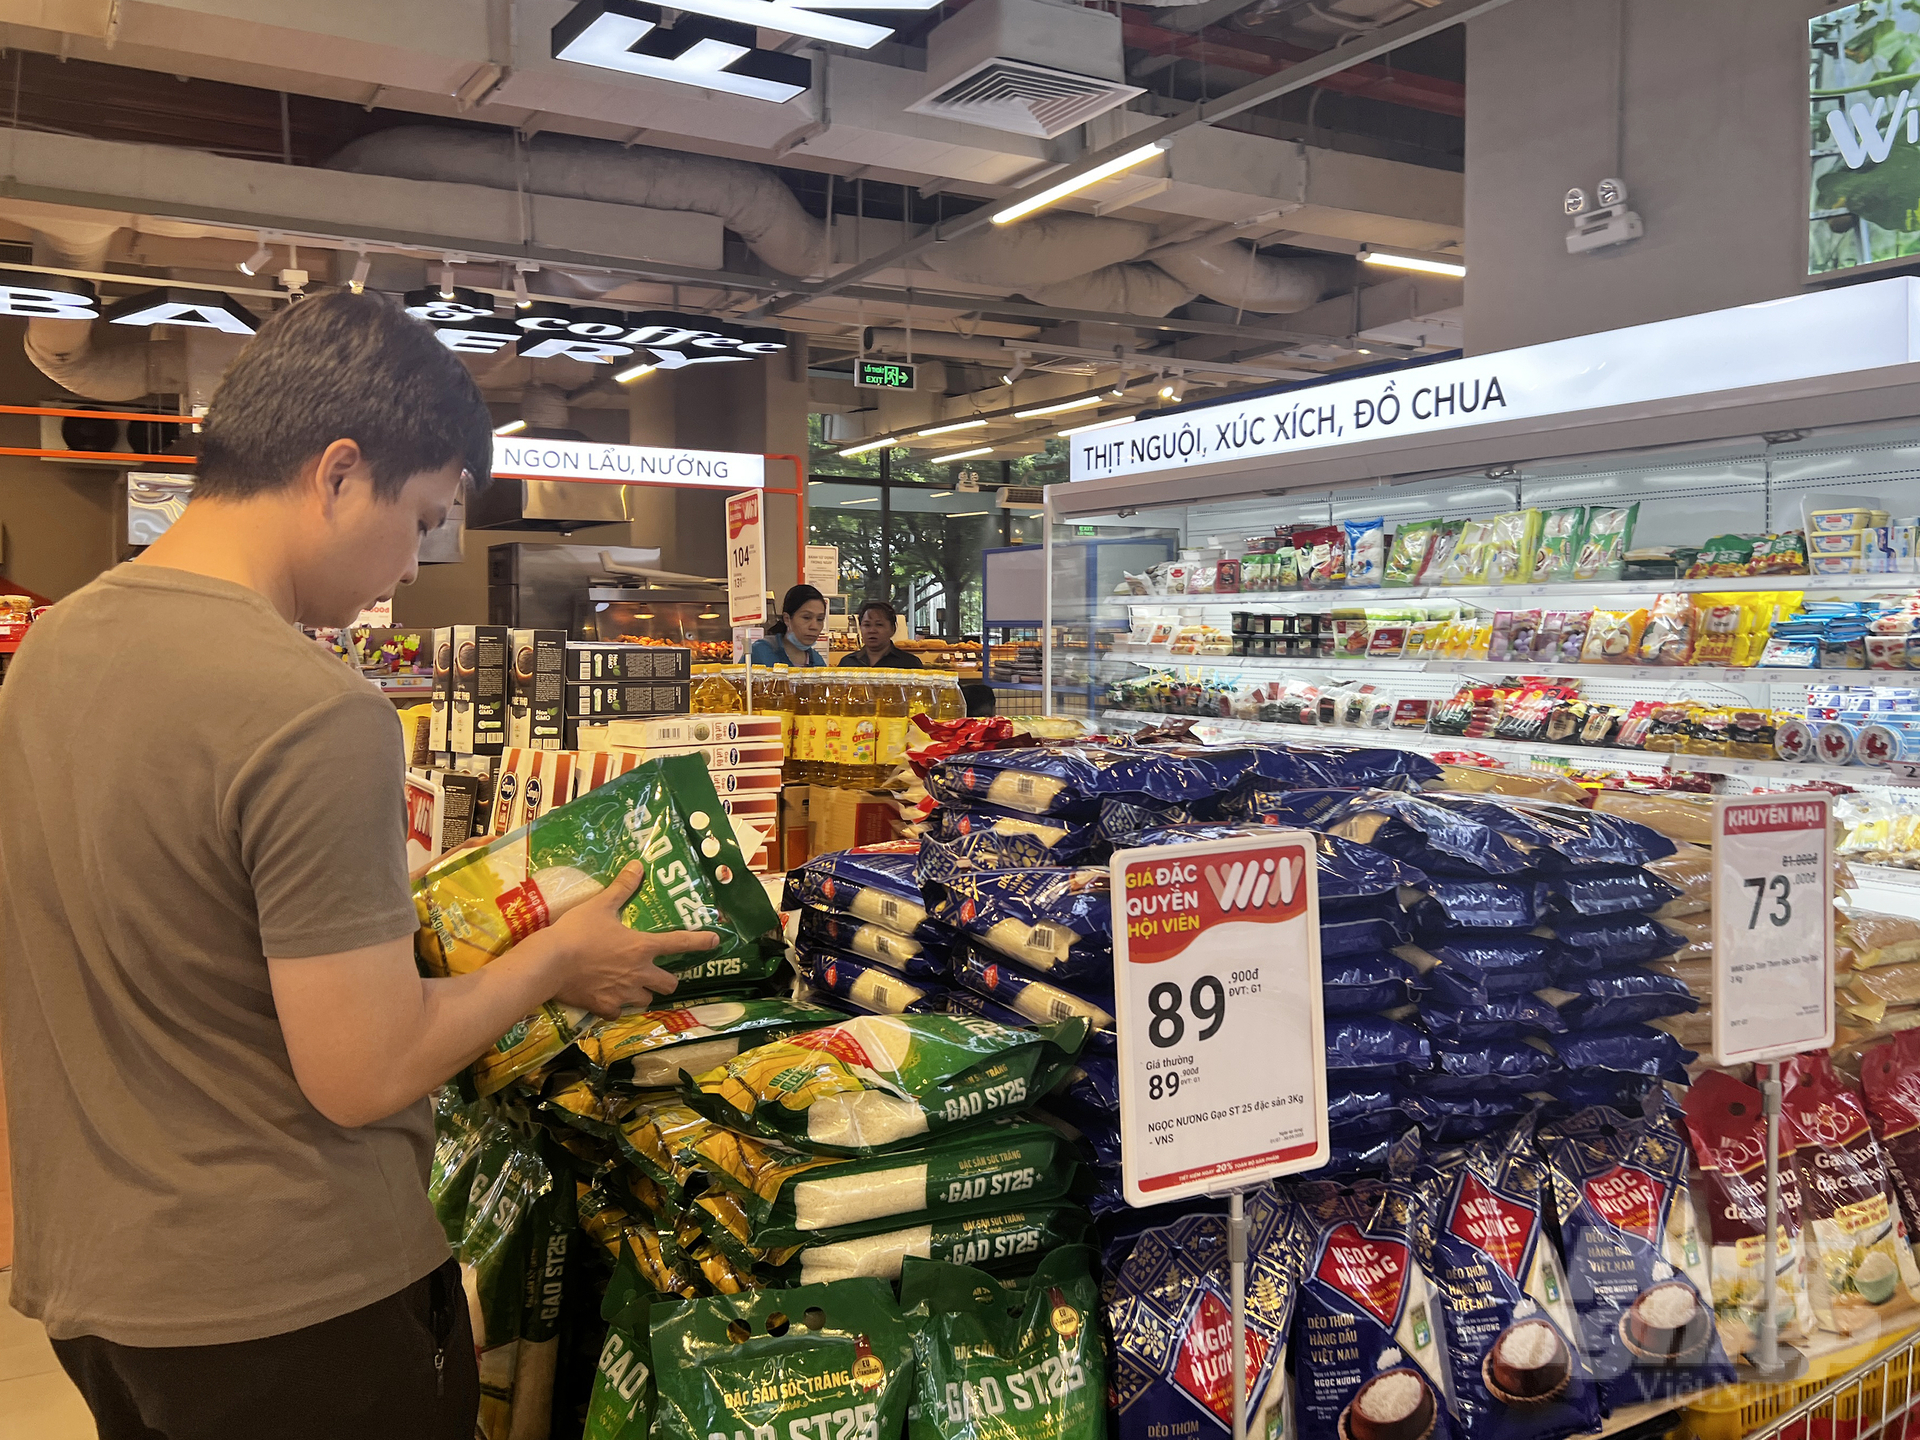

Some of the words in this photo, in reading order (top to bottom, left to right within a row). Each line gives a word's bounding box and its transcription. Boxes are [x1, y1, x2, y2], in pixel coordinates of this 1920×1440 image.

[405, 301, 495, 322] &
[514, 317, 788, 354] coffee
[866, 376, 884, 384] EXIT
[1083, 440, 1125, 474] THỊT
[1131, 421, 1207, 465] NGUỘI,
[1216, 412, 1266, 451] XÚC
[1274, 402, 1344, 443] XÍCH,
[1354, 379, 1400, 429] ĐỒ
[1411, 375, 1507, 420] CHUA
[504, 447, 579, 470] NGON
[588, 447, 635, 476] LẨU,
[640, 453, 729, 479] NƯỚNG
[733, 545, 750, 568] 104
[1728, 805, 1786, 827] KHUYẾN
[1791, 806, 1820, 828] MẠI
[624, 804, 673, 863] GẠO
[657, 859, 713, 931] ST25
[1125, 867, 1154, 888] GIÁ
[1155, 862, 1198, 888] ĐẶC
[1126, 887, 1199, 916] QUYỀN
[1743, 874, 1792, 930] 73
[1128, 919, 1158, 940] HỘI
[1162, 912, 1200, 934] VIÊN
[706, 957, 741, 978] ST25
[1228, 967, 1259, 984] .900đ
[1228, 986, 1249, 997] ĐVT:
[1251, 983, 1262, 994] G1
[1148, 974, 1226, 1048] 89
[1146, 1059, 1161, 1071] Giá
[1163, 1054, 1194, 1068] thường
[1148, 1071, 1180, 1101] 89
[944, 1091, 982, 1122] GẠO
[984, 1077, 1028, 1110] ST25
[1148, 1119, 1174, 1133] NGỌC
[1176, 1112, 1209, 1127] NƯƠNG
[1210, 1110, 1227, 1122] Gạo
[1229, 1105, 1241, 1117] ST
[1242, 1102, 1253, 1114] 25
[1254, 1100, 1270, 1113] đặc
[1271, 1096, 1286, 1108] sản
[1287, 1093, 1304, 1105] 3Kg
[1154, 1133, 1174, 1146] VNS
[958, 1156, 972, 1171] ĐẶC
[972, 1154, 986, 1167] SẢN
[999, 1149, 1022, 1162] TRĂNG
[1201, 1169, 1215, 1177] NGAY
[1215, 1161, 1234, 1173] 20%
[947, 1176, 987, 1203] GẠO
[989, 1166, 1035, 1196] ST25
[1590, 1172, 1638, 1198] NGỌC
[1461, 1197, 1503, 1221] NGỌC
[1596, 1184, 1655, 1215] NƯƠNG
[1003, 1212, 1026, 1224] TRĂNG
[1466, 1215, 1522, 1240] NƯƠNG
[544, 1233, 569, 1280] ST25
[952, 1238, 990, 1266] GẠO
[993, 1230, 1039, 1259] ST25
[1330, 1243, 1379, 1268] NGỌC
[1587, 1243, 1614, 1258] HÀNG
[1335, 1256, 1399, 1287] NƯƠNG
[1588, 1260, 1611, 1273] VIỆT
[1613, 1259, 1635, 1271] NAM
[1475, 1278, 1493, 1294] DẤU
[540, 1281, 564, 1321] GẠO
[1058, 1308, 1067, 1317] EU
[1451, 1298, 1474, 1313] VIỆT
[1475, 1296, 1497, 1309] NAM
[1307, 1313, 1327, 1330] DẺO
[1328, 1312, 1355, 1328] THƠM
[1308, 1330, 1338, 1347] HÀNG
[1339, 1327, 1358, 1345] DẤU
[599, 1333, 649, 1403] GẠO
[861, 1359, 870, 1367] EU
[1311, 1349, 1335, 1366] VIỆT
[1337, 1347, 1360, 1361] NAM
[723, 1388, 750, 1411] ĐẶC
[751, 1379, 778, 1405] SẢN
[779, 1381, 806, 1400] SÓC
[806, 1369, 850, 1392] TRĂNG
[945, 1376, 1006, 1429] GẠO
[1005, 1350, 1087, 1411] ST25
[1314, 1377, 1336, 1389] NGỌC
[1335, 1374, 1362, 1386] NƯƠNG
[1147, 1421, 1169, 1438] DẺO
[1170, 1419, 1199, 1435] THƠM
